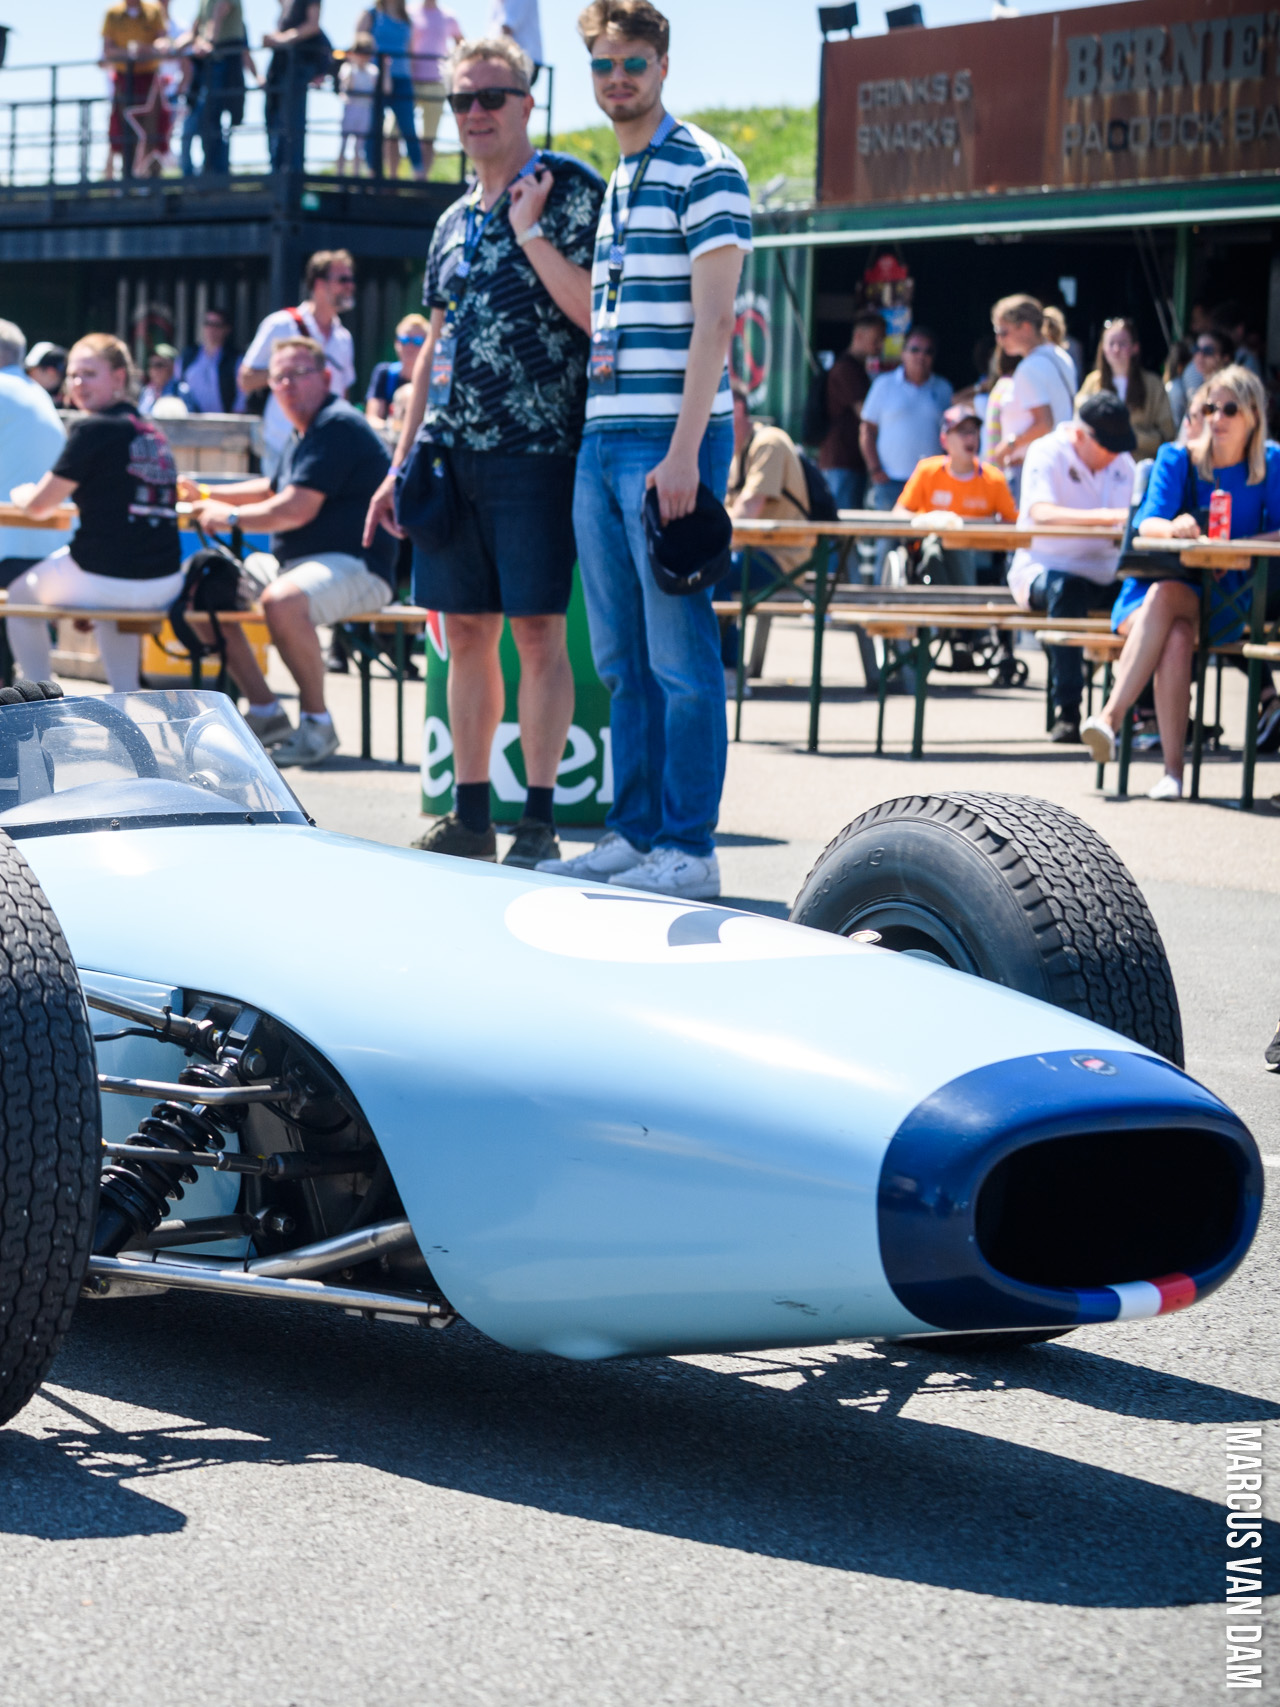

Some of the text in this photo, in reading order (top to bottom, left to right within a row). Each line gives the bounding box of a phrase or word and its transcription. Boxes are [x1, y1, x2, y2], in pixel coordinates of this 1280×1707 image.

[1065, 12, 1280, 98] BERNIE'
[858, 73, 949, 109] DRINKS
[857, 117, 956, 154] SNACKS
[1063, 107, 1225, 155] PADDOCK
